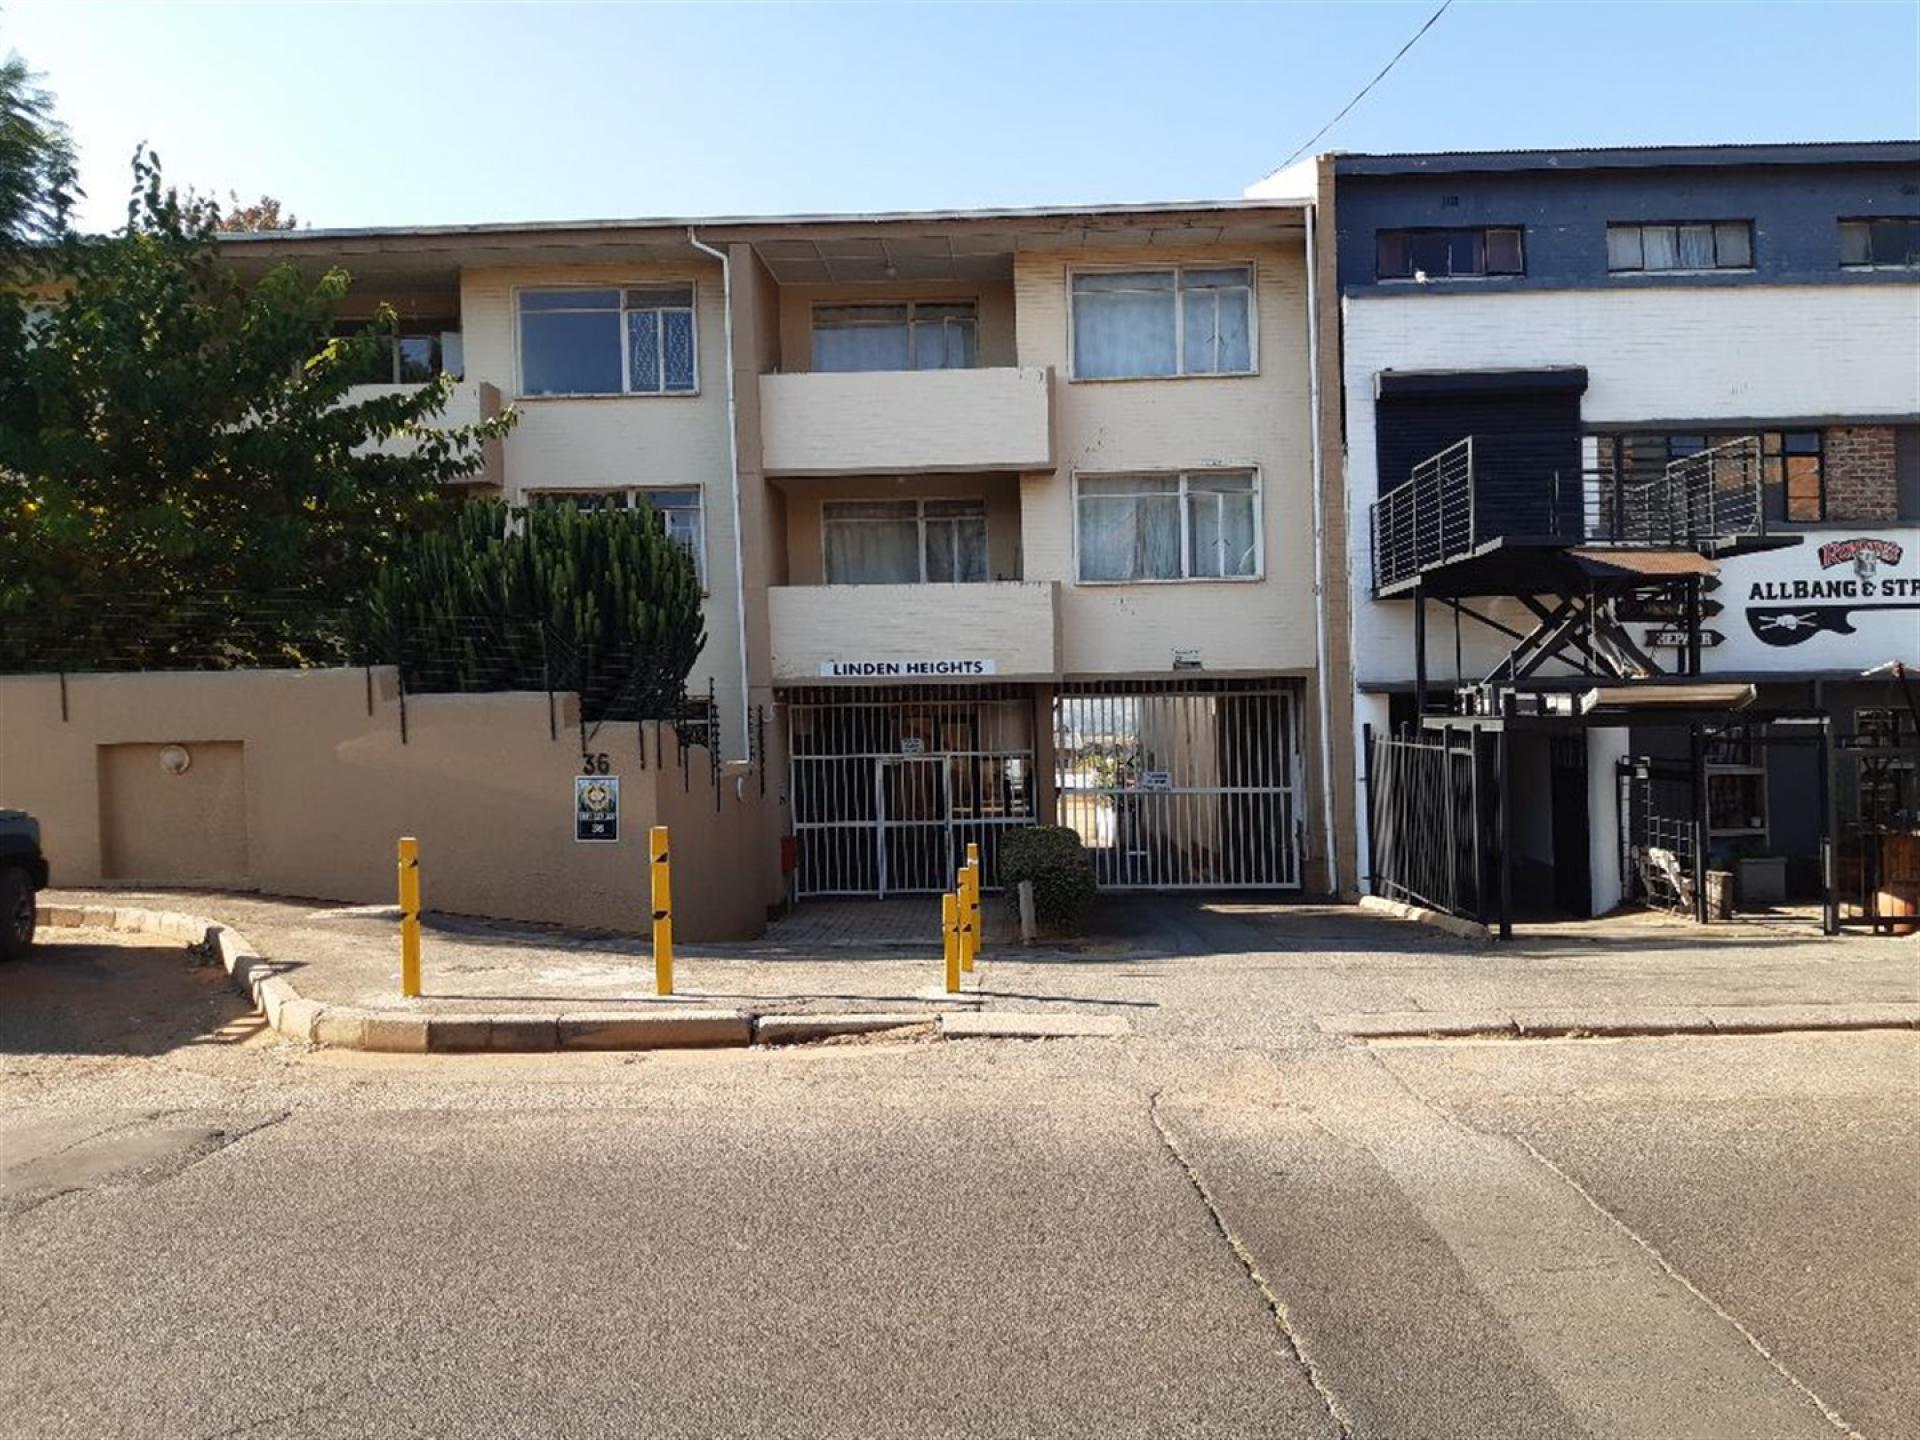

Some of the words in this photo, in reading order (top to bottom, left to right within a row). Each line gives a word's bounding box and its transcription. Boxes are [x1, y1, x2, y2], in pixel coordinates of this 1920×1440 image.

[1749, 580, 1857, 600] ALLBANG
[1862, 582, 1876, 597] &
[833, 663, 900, 676] LINDEN
[907, 661, 984, 674] HEIGHTS
[583, 753, 610, 775] 36
